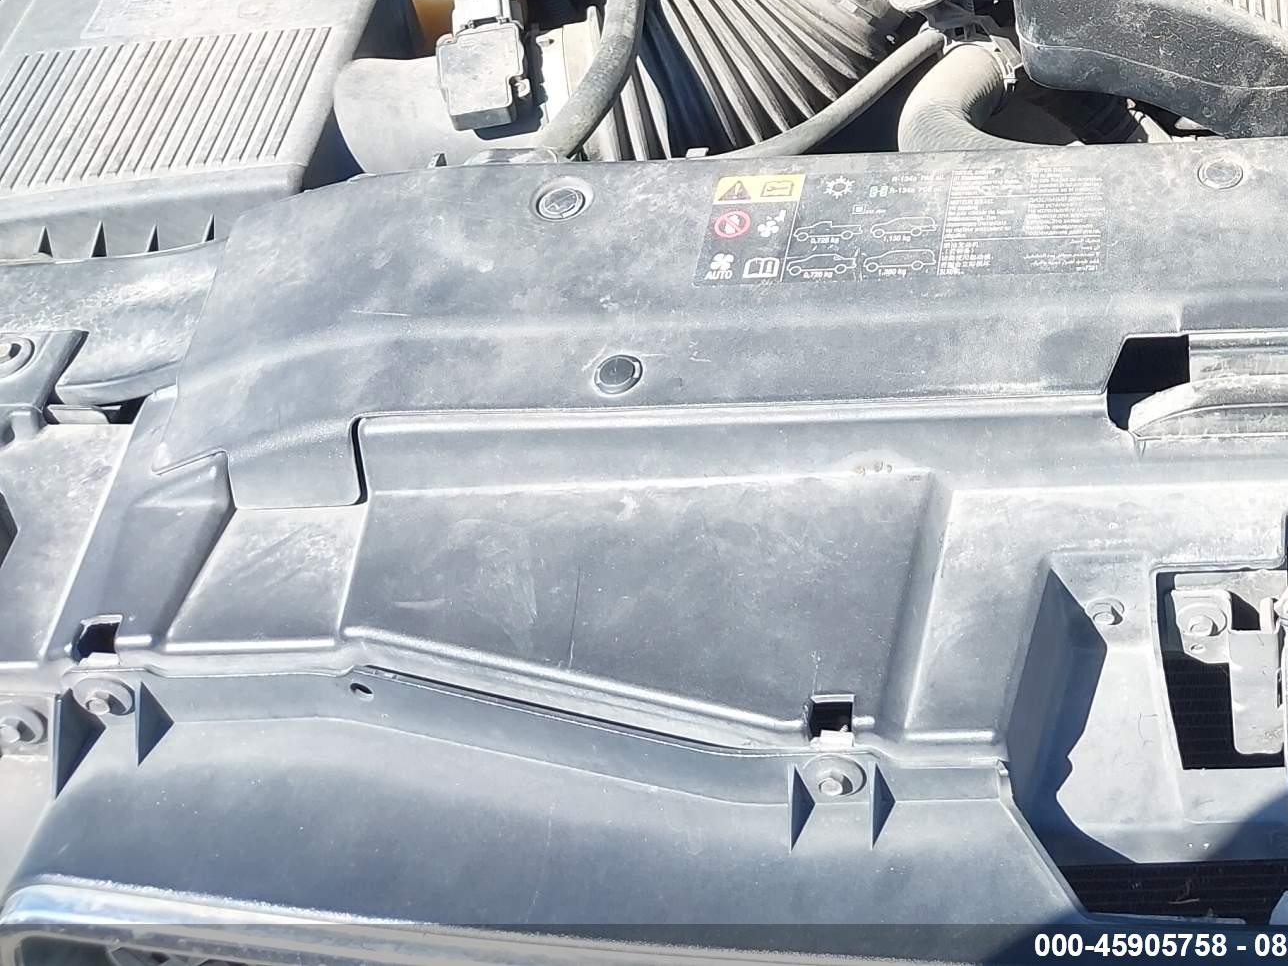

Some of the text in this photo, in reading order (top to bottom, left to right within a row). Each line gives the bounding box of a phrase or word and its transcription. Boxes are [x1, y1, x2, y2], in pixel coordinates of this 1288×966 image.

[902, 234, 911, 243] kg
[704, 269, 733, 281] AUTO
[897, 268, 906, 278] kg
